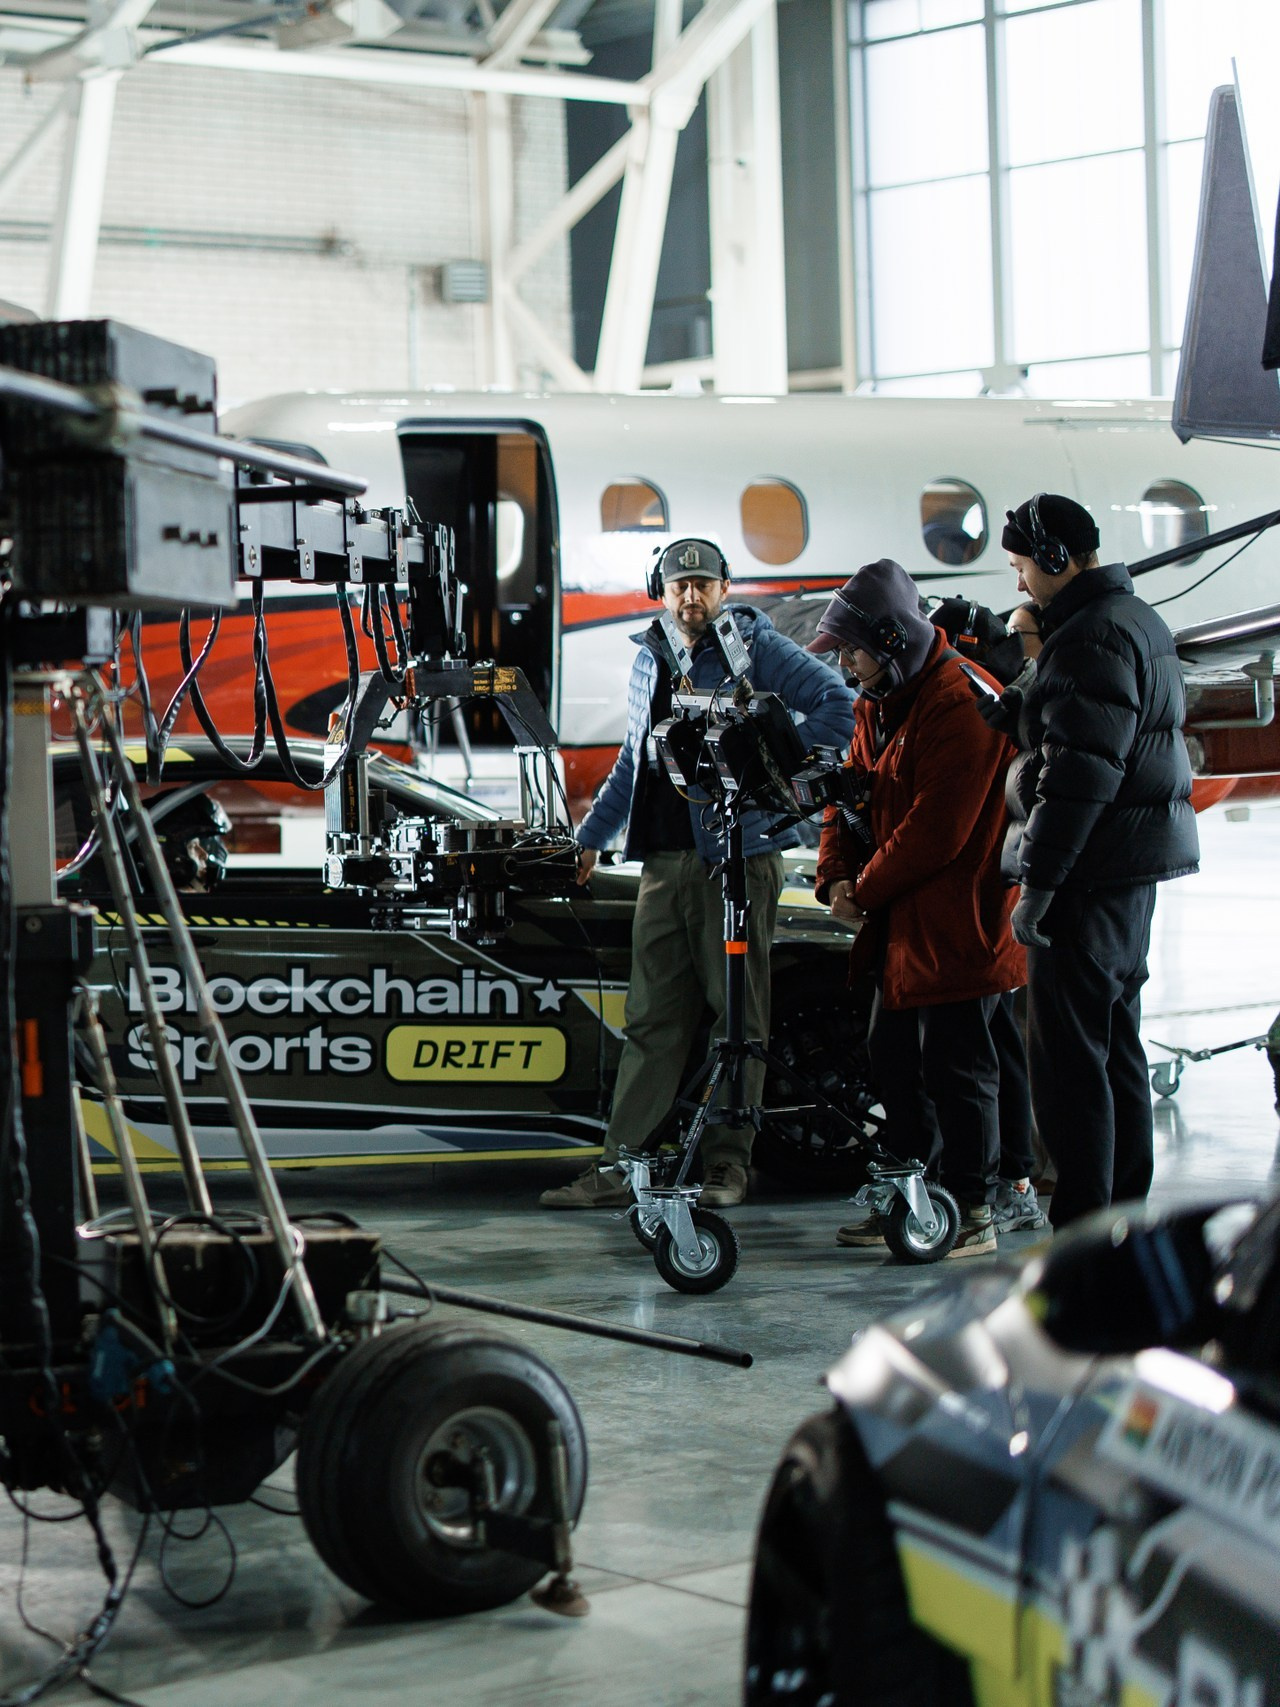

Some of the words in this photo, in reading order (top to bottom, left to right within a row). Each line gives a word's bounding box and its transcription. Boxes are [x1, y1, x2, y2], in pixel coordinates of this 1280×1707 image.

[129, 967, 518, 1015] Blockchain
[128, 1025, 371, 1080] Sports
[413, 1040, 542, 1069] DRIFT
